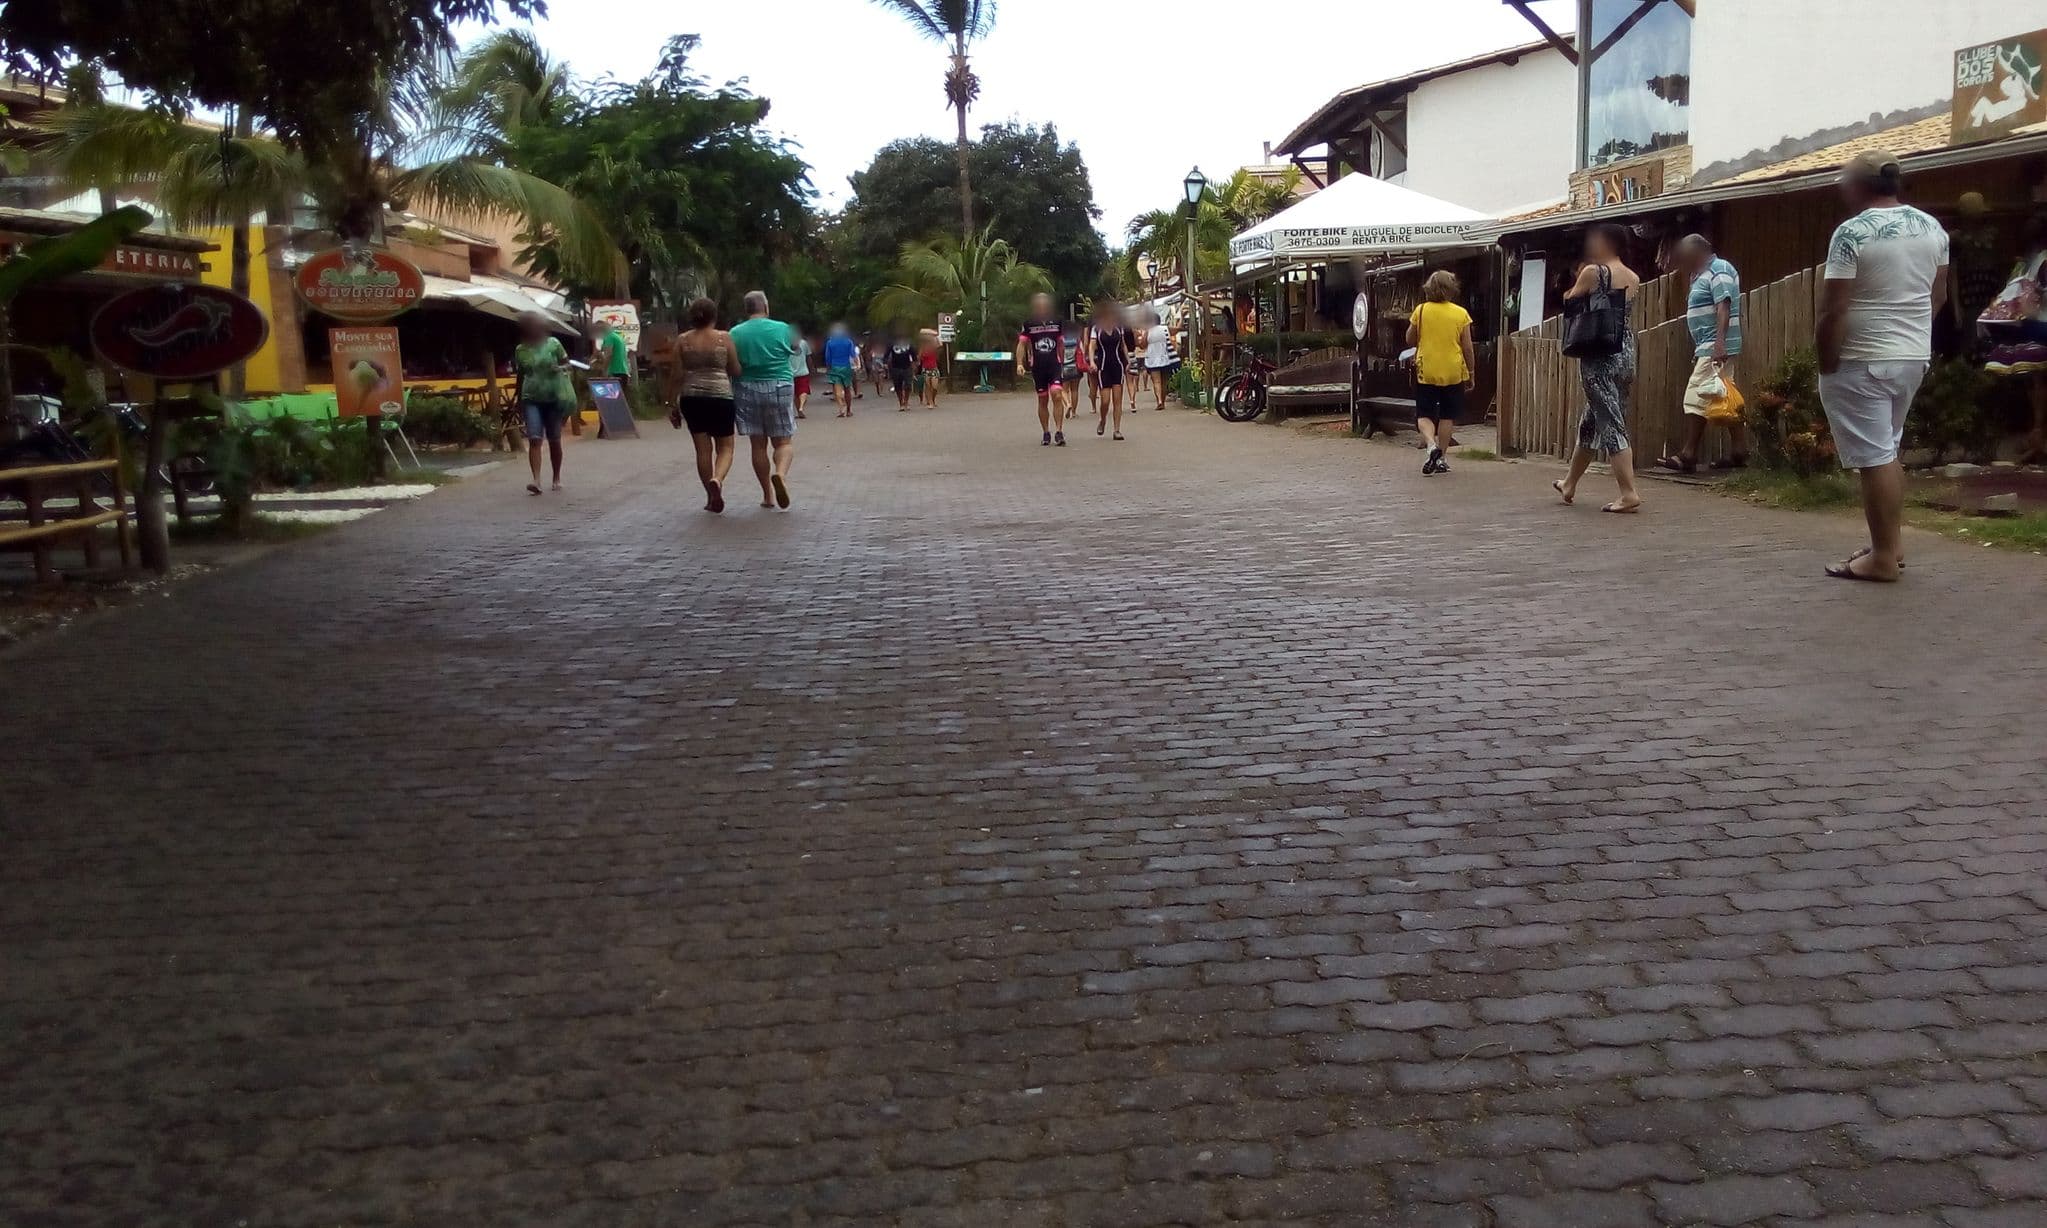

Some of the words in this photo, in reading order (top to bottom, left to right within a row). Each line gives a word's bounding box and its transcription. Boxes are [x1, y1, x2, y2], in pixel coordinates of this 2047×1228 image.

[1957, 44, 1996, 64] CLUBE
[1957, 57, 1995, 79] DOS
[1284, 228, 1319, 237] FORTE
[1322, 227, 1347, 236] BIKE
[1352, 227, 1397, 238] ALUGUEL
[1399, 226, 1412, 235] DE
[1352, 236, 1378, 246] RENT
[1380, 235, 1387, 244] A
[1389, 234, 1412, 243] BIKE
[115, 249, 194, 271] ETERIA
